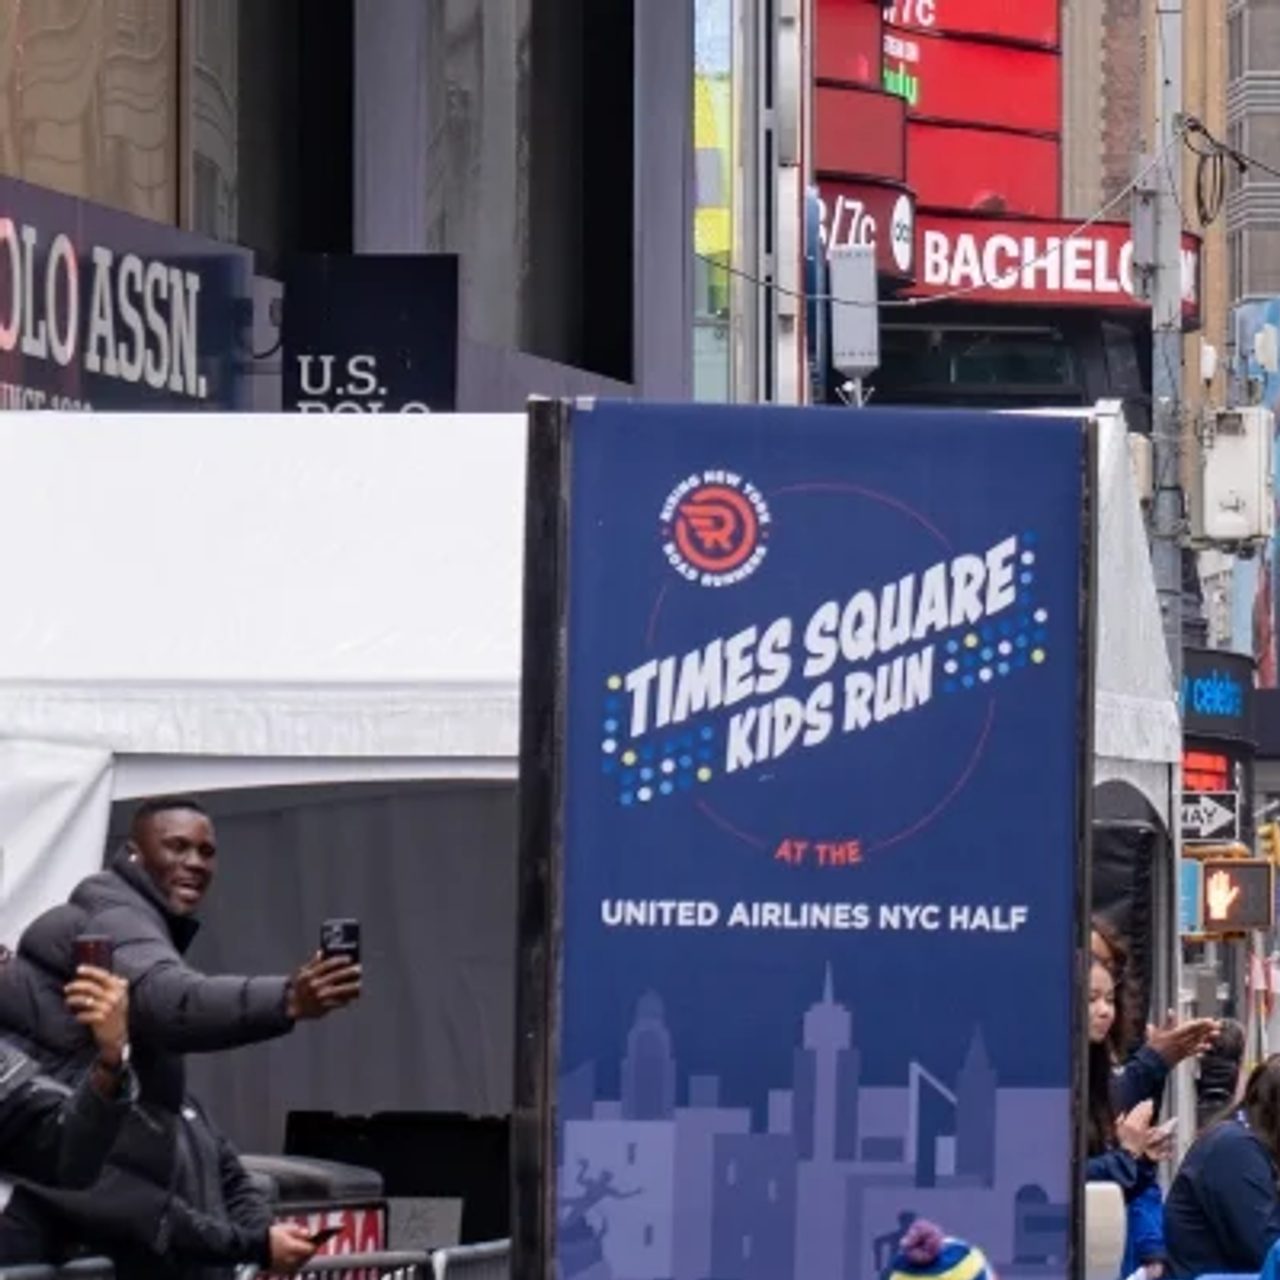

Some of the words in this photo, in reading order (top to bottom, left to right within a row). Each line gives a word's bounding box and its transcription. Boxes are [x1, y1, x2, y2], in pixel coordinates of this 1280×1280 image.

[924, 229, 1140, 299] BACHEL
[85, 245, 207, 397] ASSN.
[298, 354, 387, 395] U.S.
[704, 470, 741, 486] NEW
[742, 482, 770, 524] YORK
[663, 543, 698, 580] ROAD
[624, 616, 793, 738] TIMES
[803, 535, 1017, 678] SQUARE
[726, 681, 833, 773] KIDS
[843, 645, 935, 732] RUN
[775, 840, 804, 862] AT
[815, 841, 862, 866] THE
[601, 900, 719, 927] UNITED
[727, 901, 870, 930] AIRLINES
[879, 904, 941, 931] NYC
[949, 905, 1028, 932] HALF
